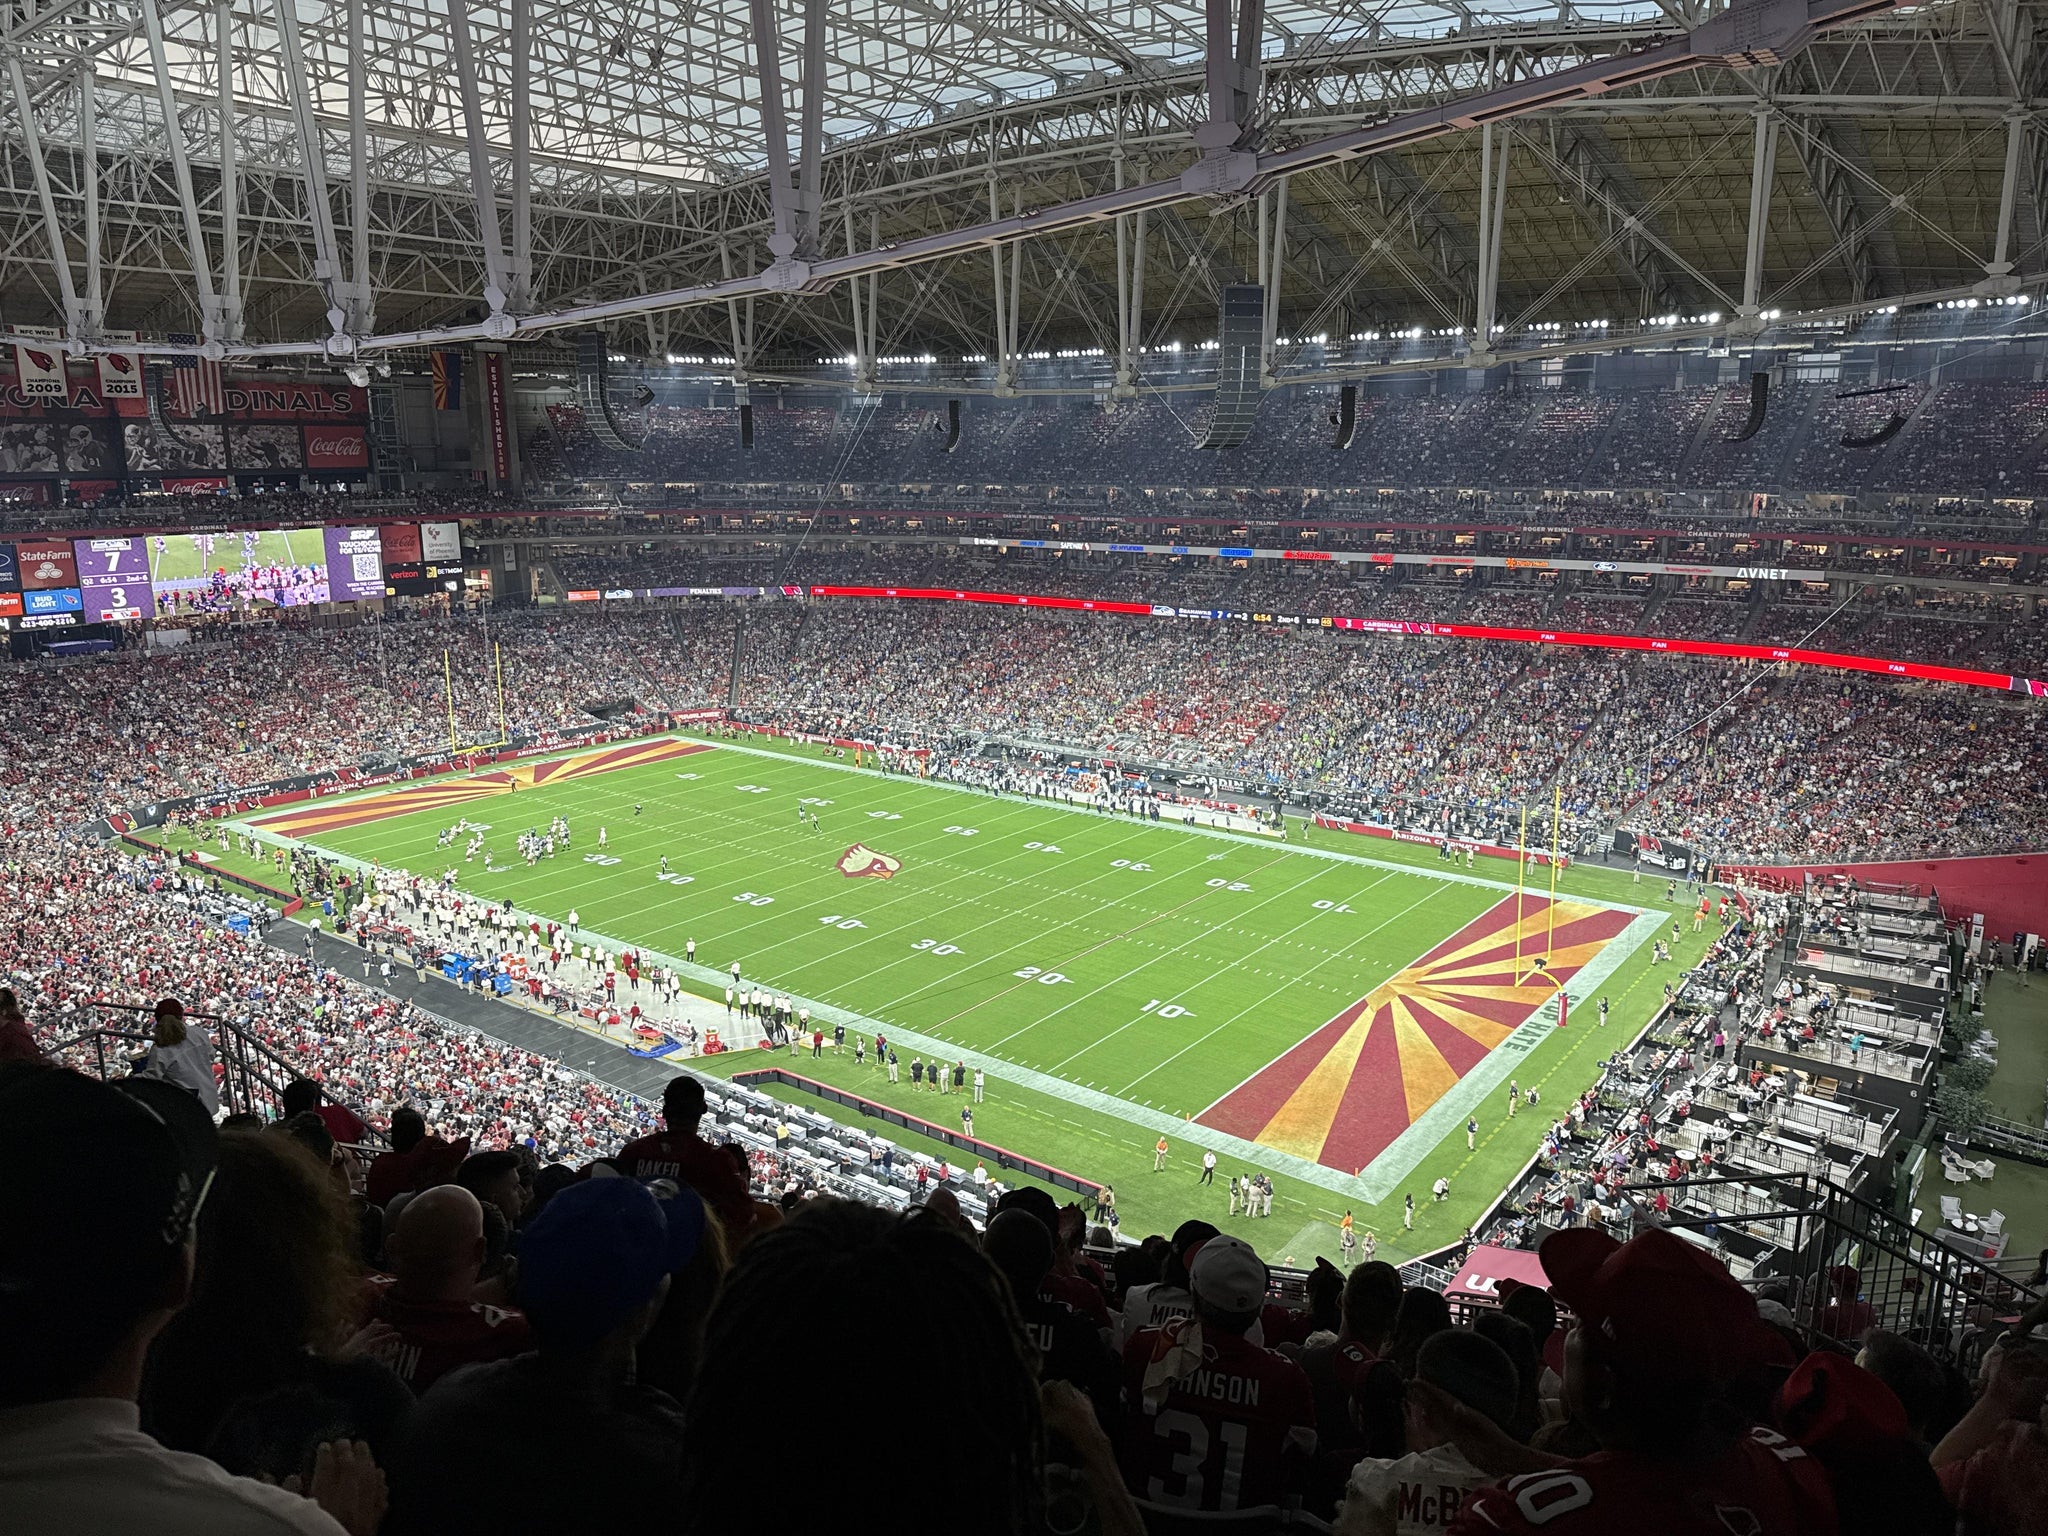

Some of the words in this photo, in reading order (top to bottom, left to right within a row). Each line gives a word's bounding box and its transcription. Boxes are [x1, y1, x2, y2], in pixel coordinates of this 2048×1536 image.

[27, 384, 62, 393] 2009
[106, 384, 138, 394] 2015
[490, 366, 503, 449] ESTABLISHED
[309, 437, 362, 456] Coca-Cola
[104, 551, 120, 572] 7
[390, 571, 418, 579] verizon
[438, 567, 463, 575] BETMGM
[1736, 567, 1789, 580] AVNET
[82, 578, 94, 586] Q2
[110, 587, 127, 607] 3
[759, 587, 765, 595] 3
[1178, 608, 1212, 616] SEAHAWKS
[1253, 613, 1272, 622] 6:54
[1346, 620, 1352, 628] 3
[1363, 621, 1403, 629] CARDINALS
[416, 753, 446, 763] ARIZONA
[516, 746, 547, 757] ARIZONA
[230, 785, 270, 797] CARDINALS
[1397, 833, 1432, 844] ARIZONA
[1023, 841, 1058, 854] 40
[583, 853, 622, 866] 30
[1110, 858, 1150, 872] 30
[655, 871, 695, 885] 40
[1205, 878, 1248, 892] 20
[732, 891, 775, 906] 50
[1311, 899, 1350, 913] 10
[818, 915, 861, 930] 40
[910, 939, 958, 956] 30
[1012, 967, 1062, 985] 20
[1140, 999, 1184, 1019] 10
[1503, 1021, 1551, 1052] HATE
[1909, 1090, 1918, 1098] 6
[636, 1159, 681, 1177] BAKER
[1147, 1408, 1248, 1511] 31
